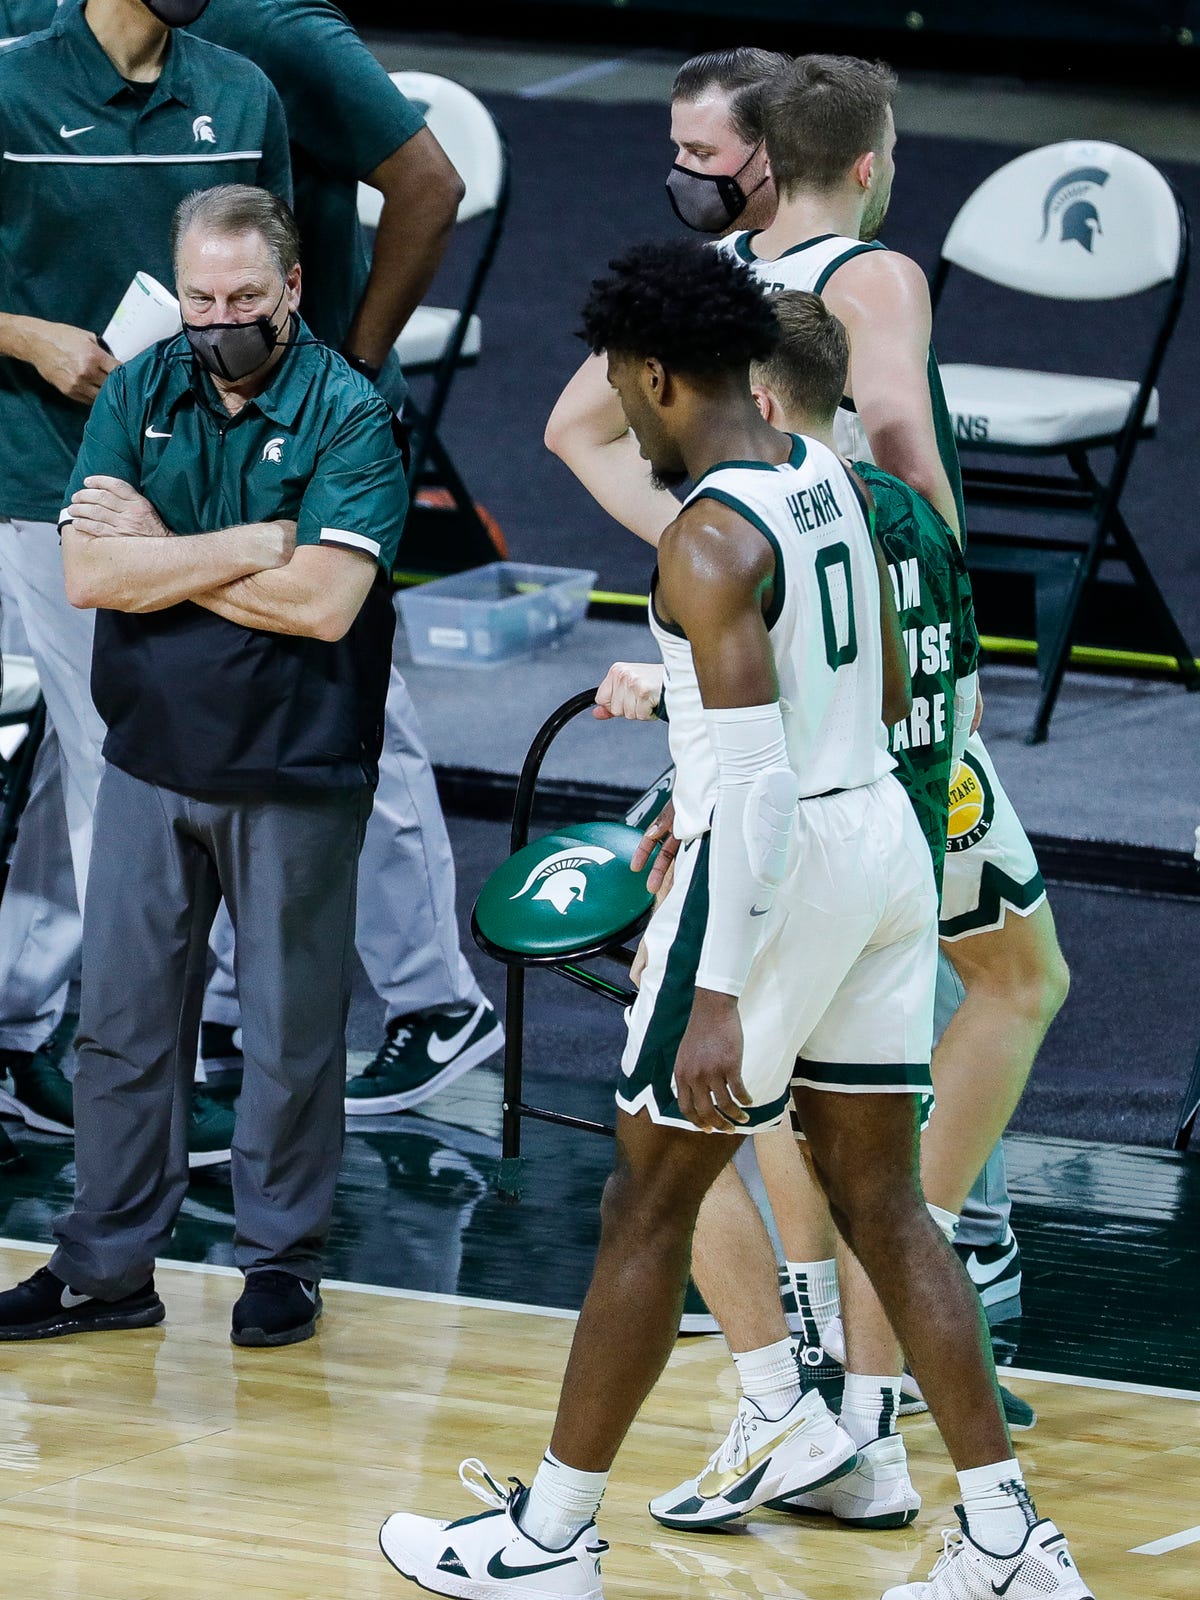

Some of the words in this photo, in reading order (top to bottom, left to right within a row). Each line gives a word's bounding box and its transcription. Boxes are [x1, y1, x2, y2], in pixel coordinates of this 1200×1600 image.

[784, 478, 843, 535] HENRY
[814, 541, 858, 673] 0
[946, 819, 990, 851] STATE
